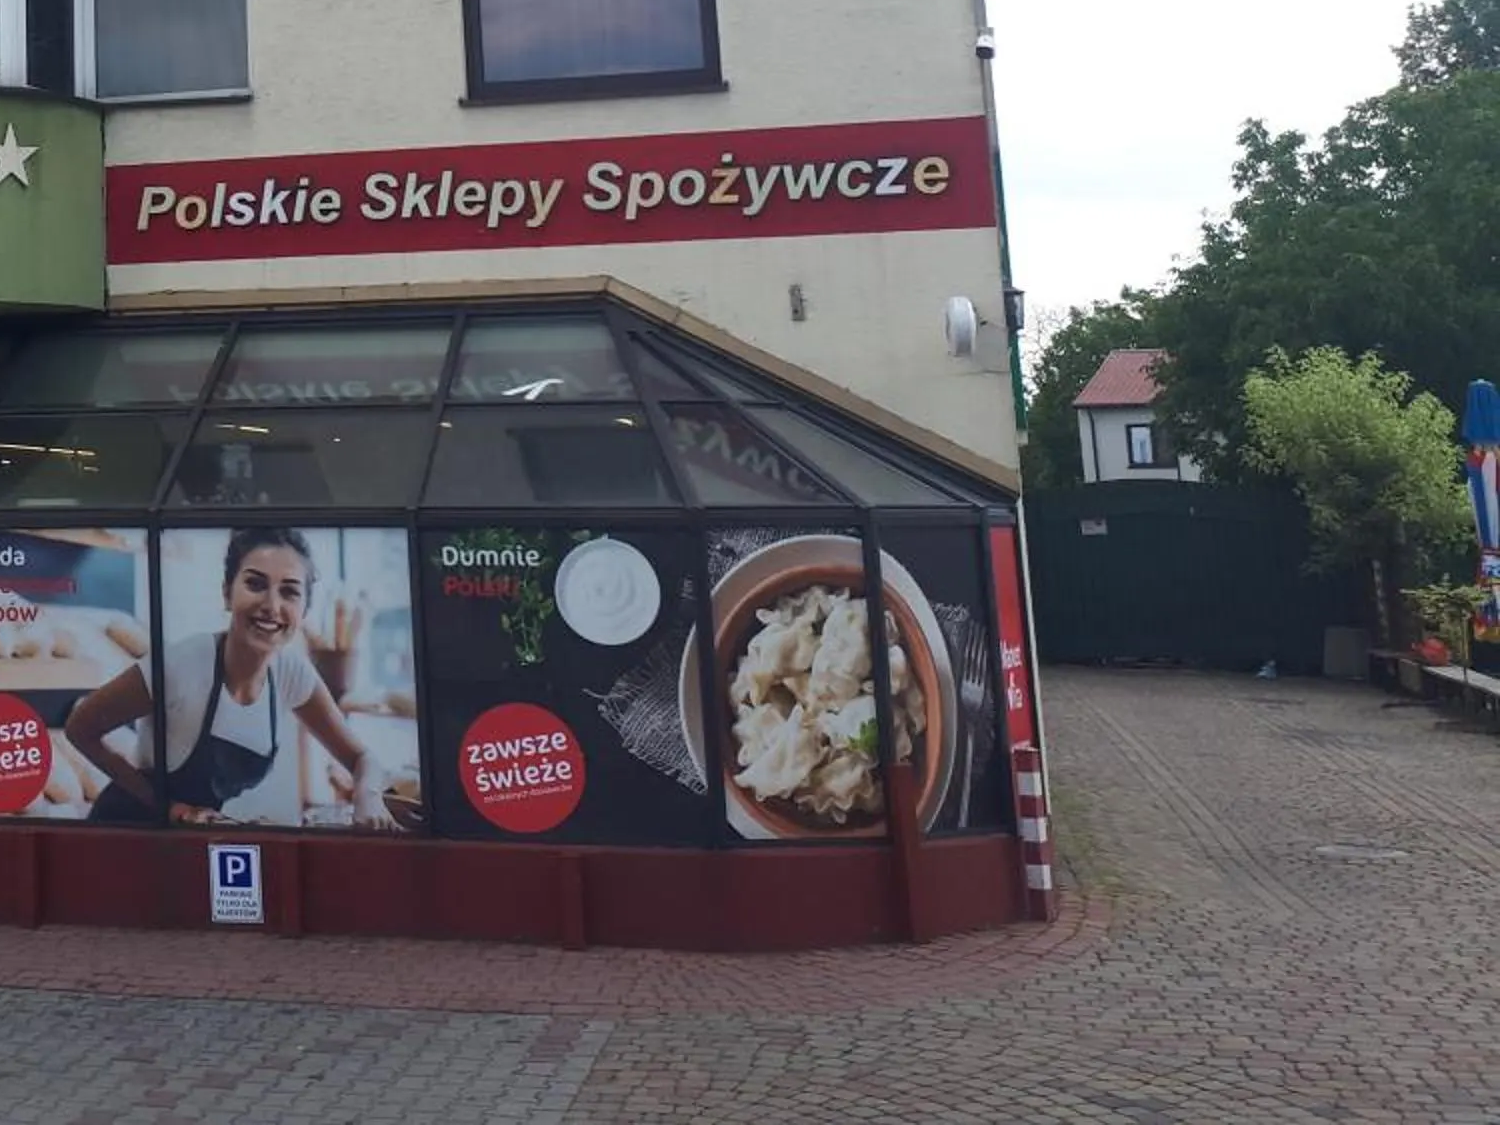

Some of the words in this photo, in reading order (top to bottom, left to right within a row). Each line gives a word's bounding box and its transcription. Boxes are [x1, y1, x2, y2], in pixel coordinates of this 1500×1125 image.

[136, 178, 342, 231] Polskie
[360, 170, 564, 228] Sklepy
[582, 152, 950, 221] Spożywcze
[441, 545, 541, 567] Dumnie
[467, 732, 568, 764] zawsze
[475, 757, 573, 792] świeże
